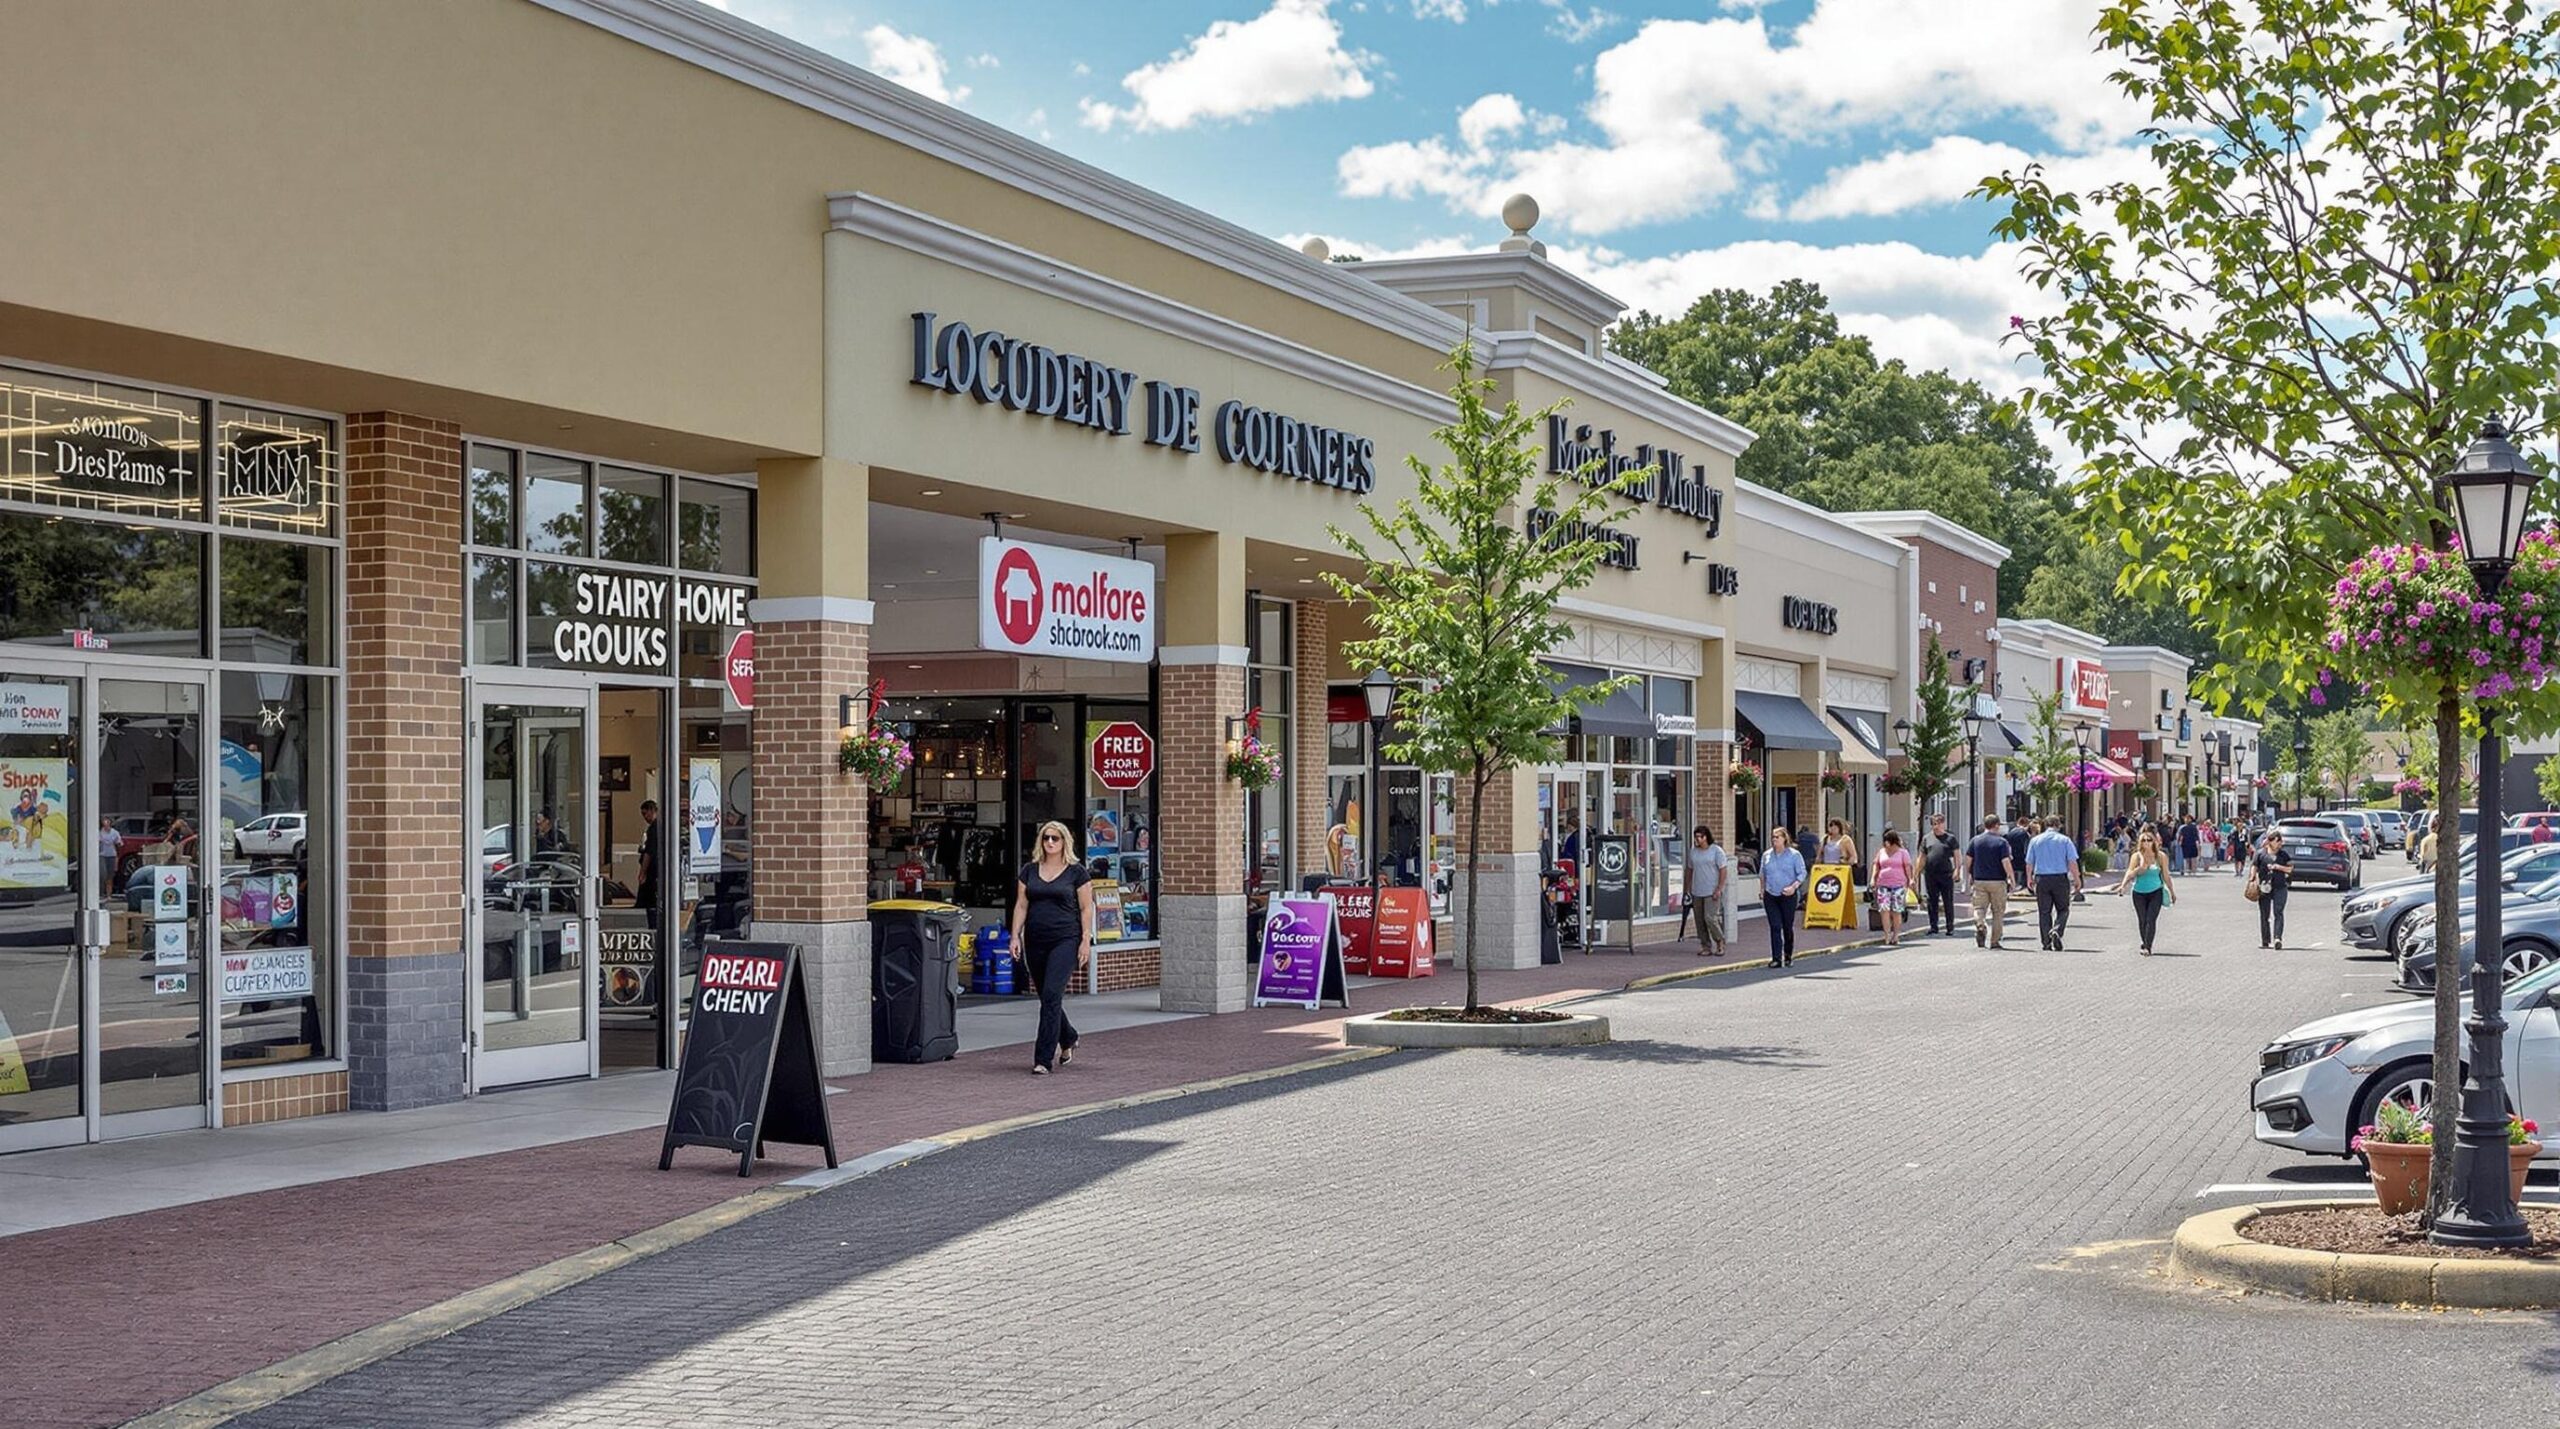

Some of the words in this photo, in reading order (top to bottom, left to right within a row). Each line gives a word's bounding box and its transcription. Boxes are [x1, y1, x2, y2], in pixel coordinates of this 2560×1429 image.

[910, 312, 1138, 435] LOCUDERY
[1144, 380, 1199, 453] DE
[576, 572, 667, 619] STAIRY
[675, 582, 746, 626] HOME
[554, 620, 667, 667] CROUKS
[704, 956, 780, 988] DREARL
[701, 987, 774, 1015] CHENY
